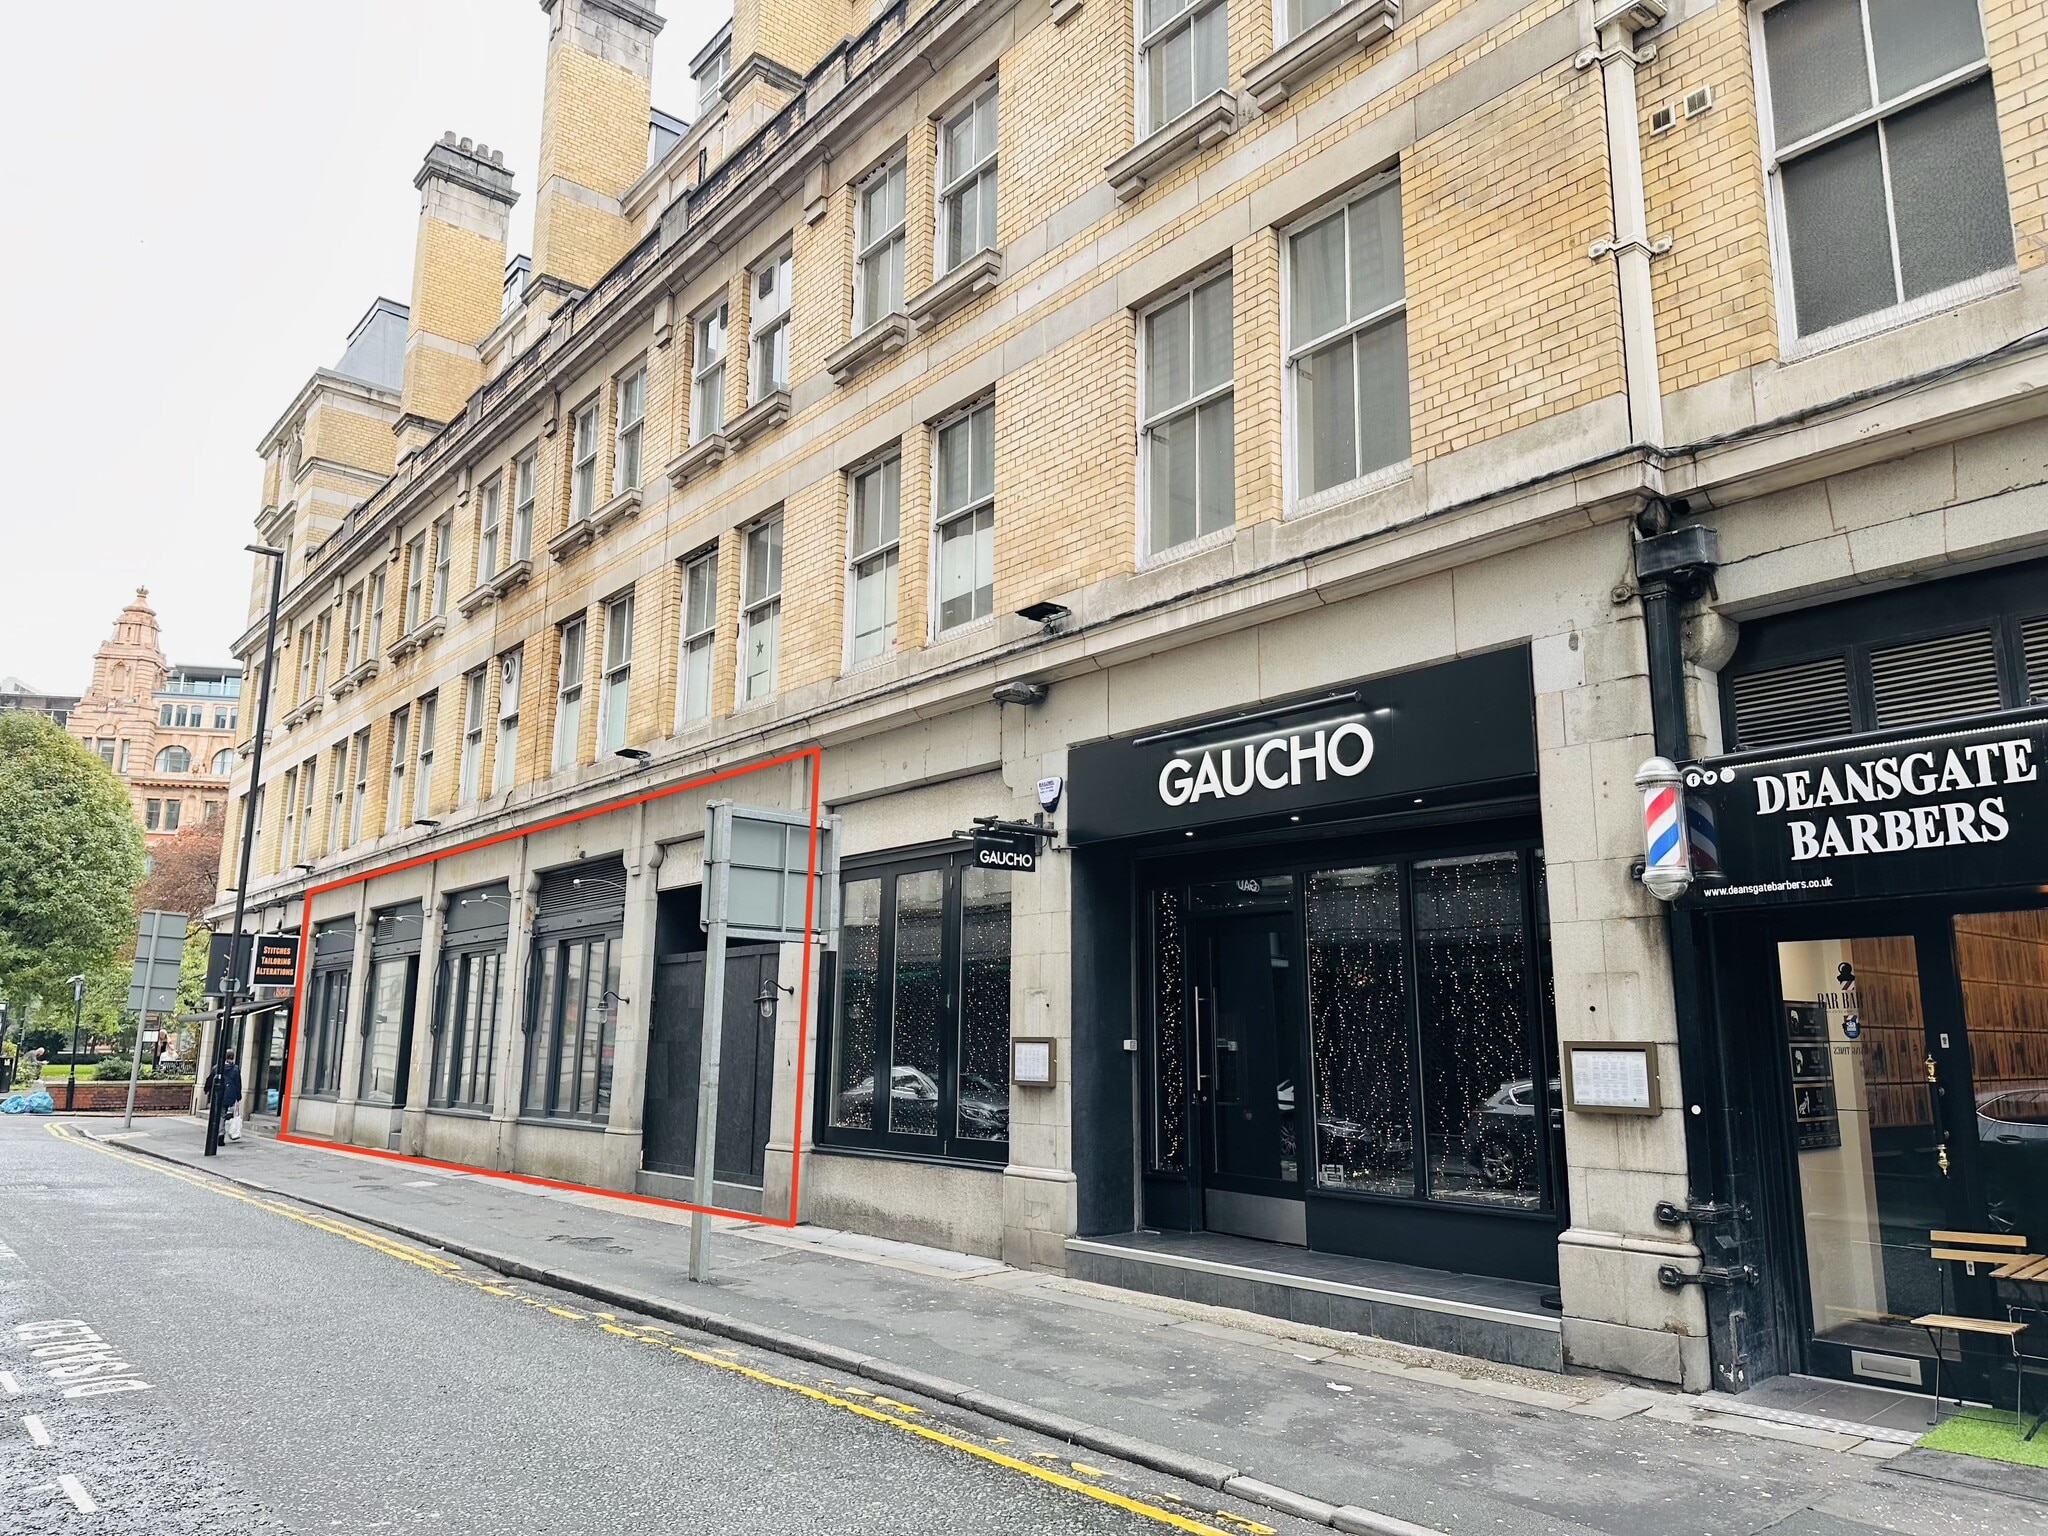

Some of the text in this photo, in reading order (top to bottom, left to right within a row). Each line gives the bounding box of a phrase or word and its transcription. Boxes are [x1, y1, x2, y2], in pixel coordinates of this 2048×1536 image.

[1158, 722, 1374, 807] GAUCHO
[1753, 738, 2037, 816] DEANSGATE
[1787, 797, 2009, 861] BARBERS
[978, 849, 1033, 869] GAUCHO
[1704, 876, 1833, 897] www.deansgatebarbers.co.uk
[261, 956, 291, 965] TAILORING
[263, 946, 291, 955] STITCHES
[256, 967, 294, 976] ALTERATIONS
[1817, 993, 1839, 1009] BAR
